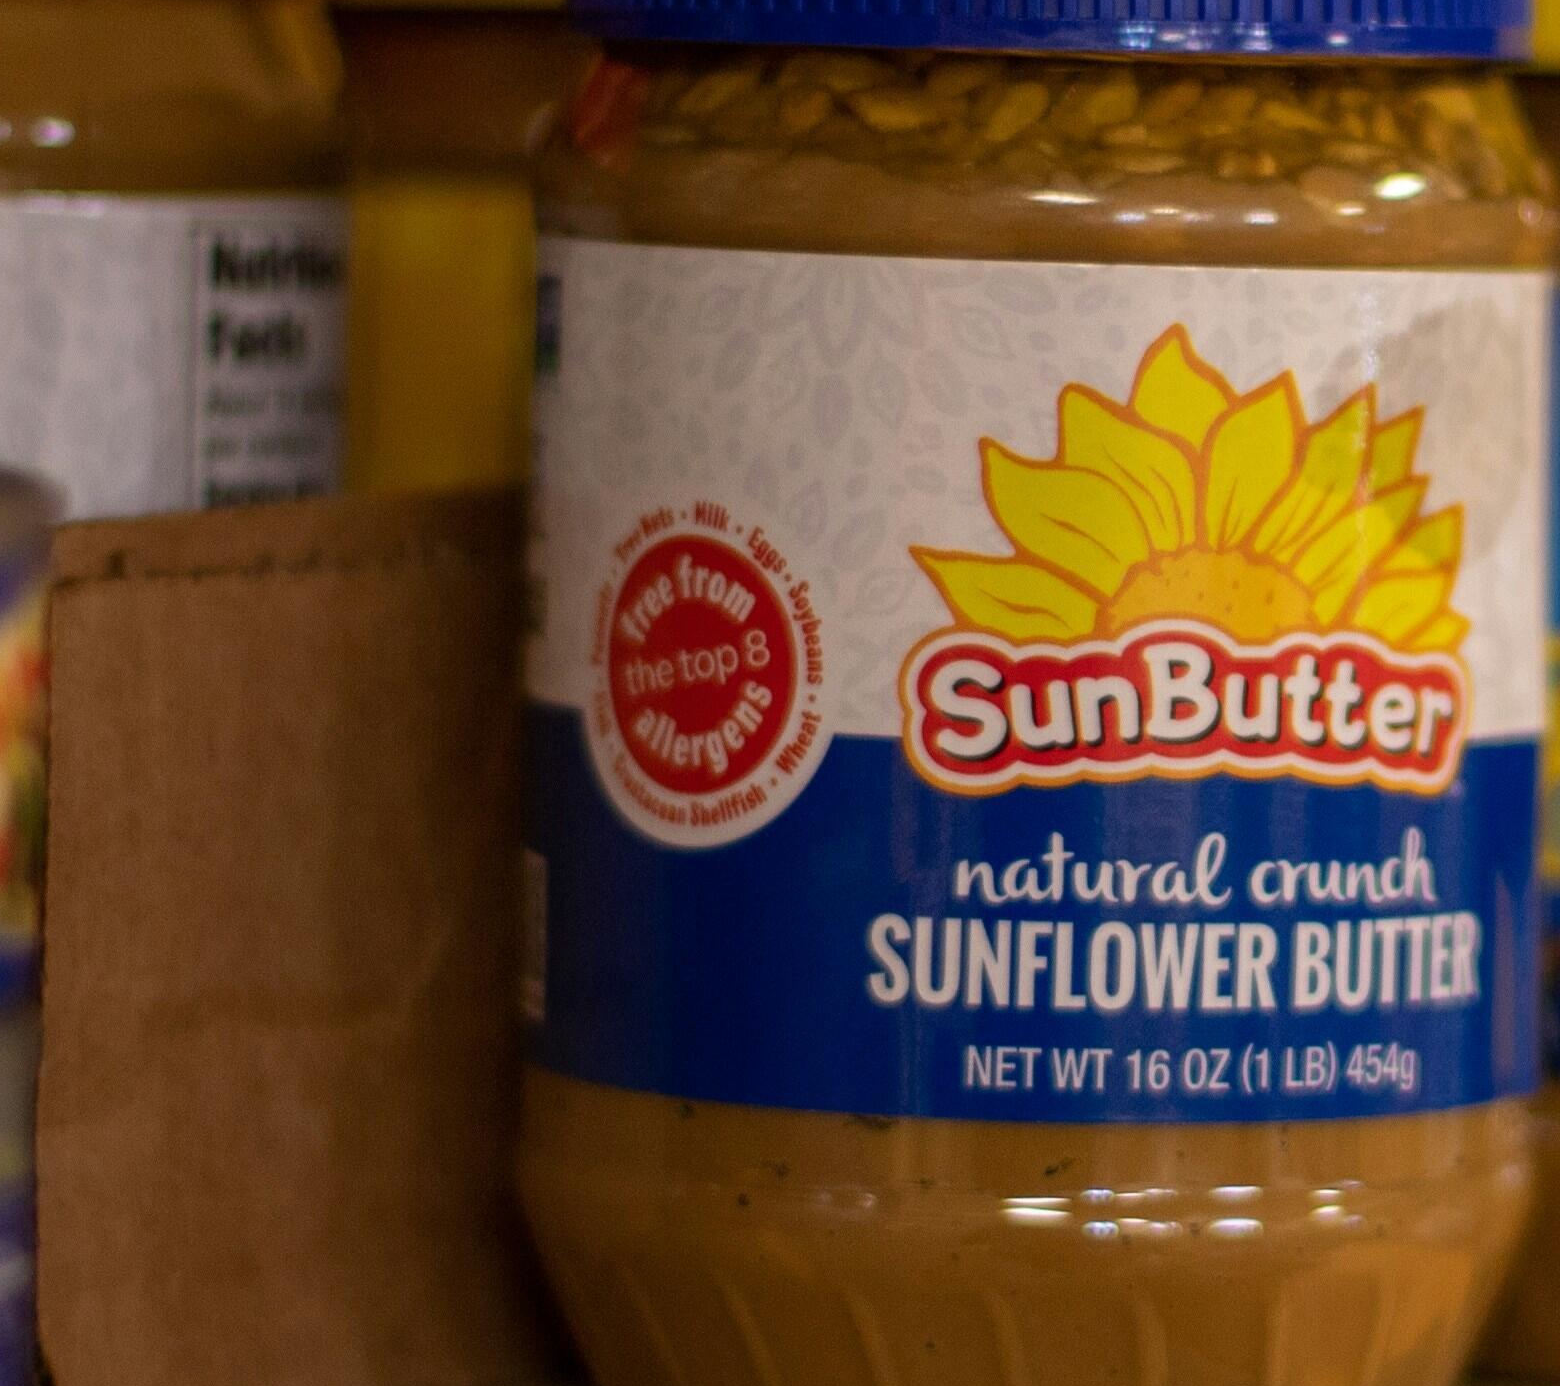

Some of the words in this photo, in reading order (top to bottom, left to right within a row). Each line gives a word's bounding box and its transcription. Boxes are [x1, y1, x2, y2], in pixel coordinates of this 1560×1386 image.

[208, 313, 304, 362] Facts
[695, 500, 731, 533] Milk
[748, 525, 789, 576] Eggs
[620, 573, 675, 647] free
[677, 553, 758, 625] from
[789, 579, 824, 689] Soybeans
[625, 651, 675, 696] the
[679, 643, 739, 686] top
[745, 628, 771, 667] 8
[635, 680, 774, 777] allergens
[929, 641, 1456, 761] SunButter
[774, 710, 822, 776] Wheat
[689, 781, 769, 828] Shellfish
[955, 829, 1233, 905] natural
[1249, 825, 1439, 904] crunch
[866, 913, 1278, 1010] SUNFLOWER
[1293, 910, 1481, 1009] BUTTER
[965, 1044, 1042, 1090] NET
[1051, 1047, 1113, 1090] WT
[1127, 1049, 1171, 1091] 16
[1183, 1047, 1231, 1090] OZ
[1241, 1042, 1271, 1095] (1
[1284, 1040, 1338, 1092] LB)
[1345, 1041, 1418, 1094] 454g
